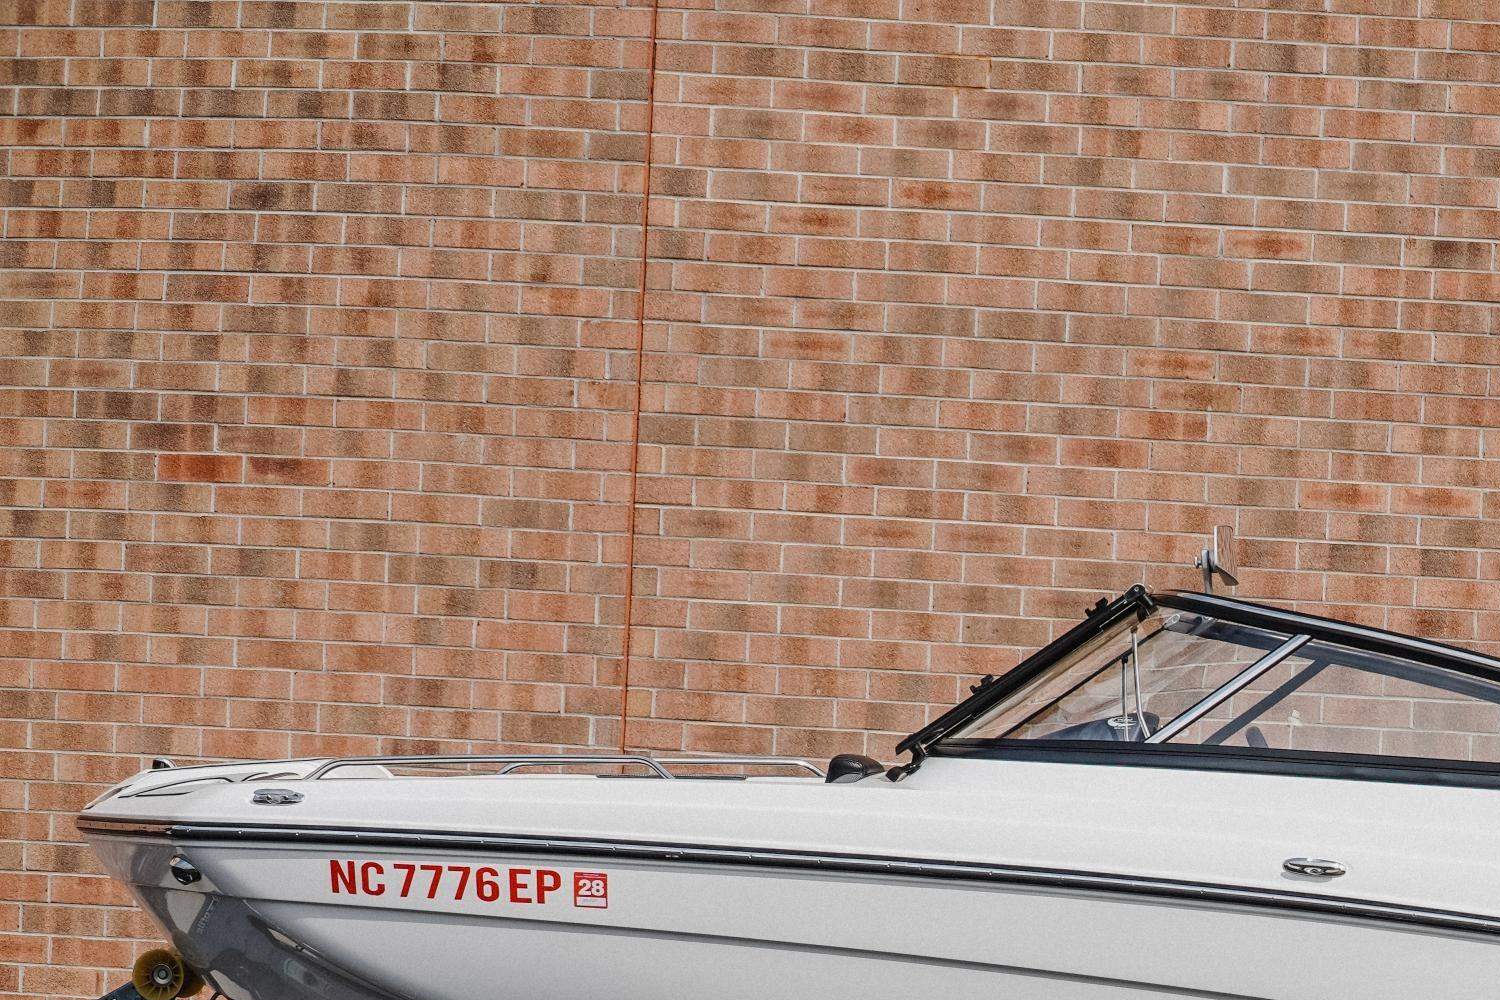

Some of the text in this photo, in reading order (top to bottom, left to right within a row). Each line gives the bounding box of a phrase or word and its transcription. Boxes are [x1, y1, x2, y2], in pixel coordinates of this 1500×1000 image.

[330, 860, 562, 905] NC 7776 EP
[578, 879, 605, 897] 28
